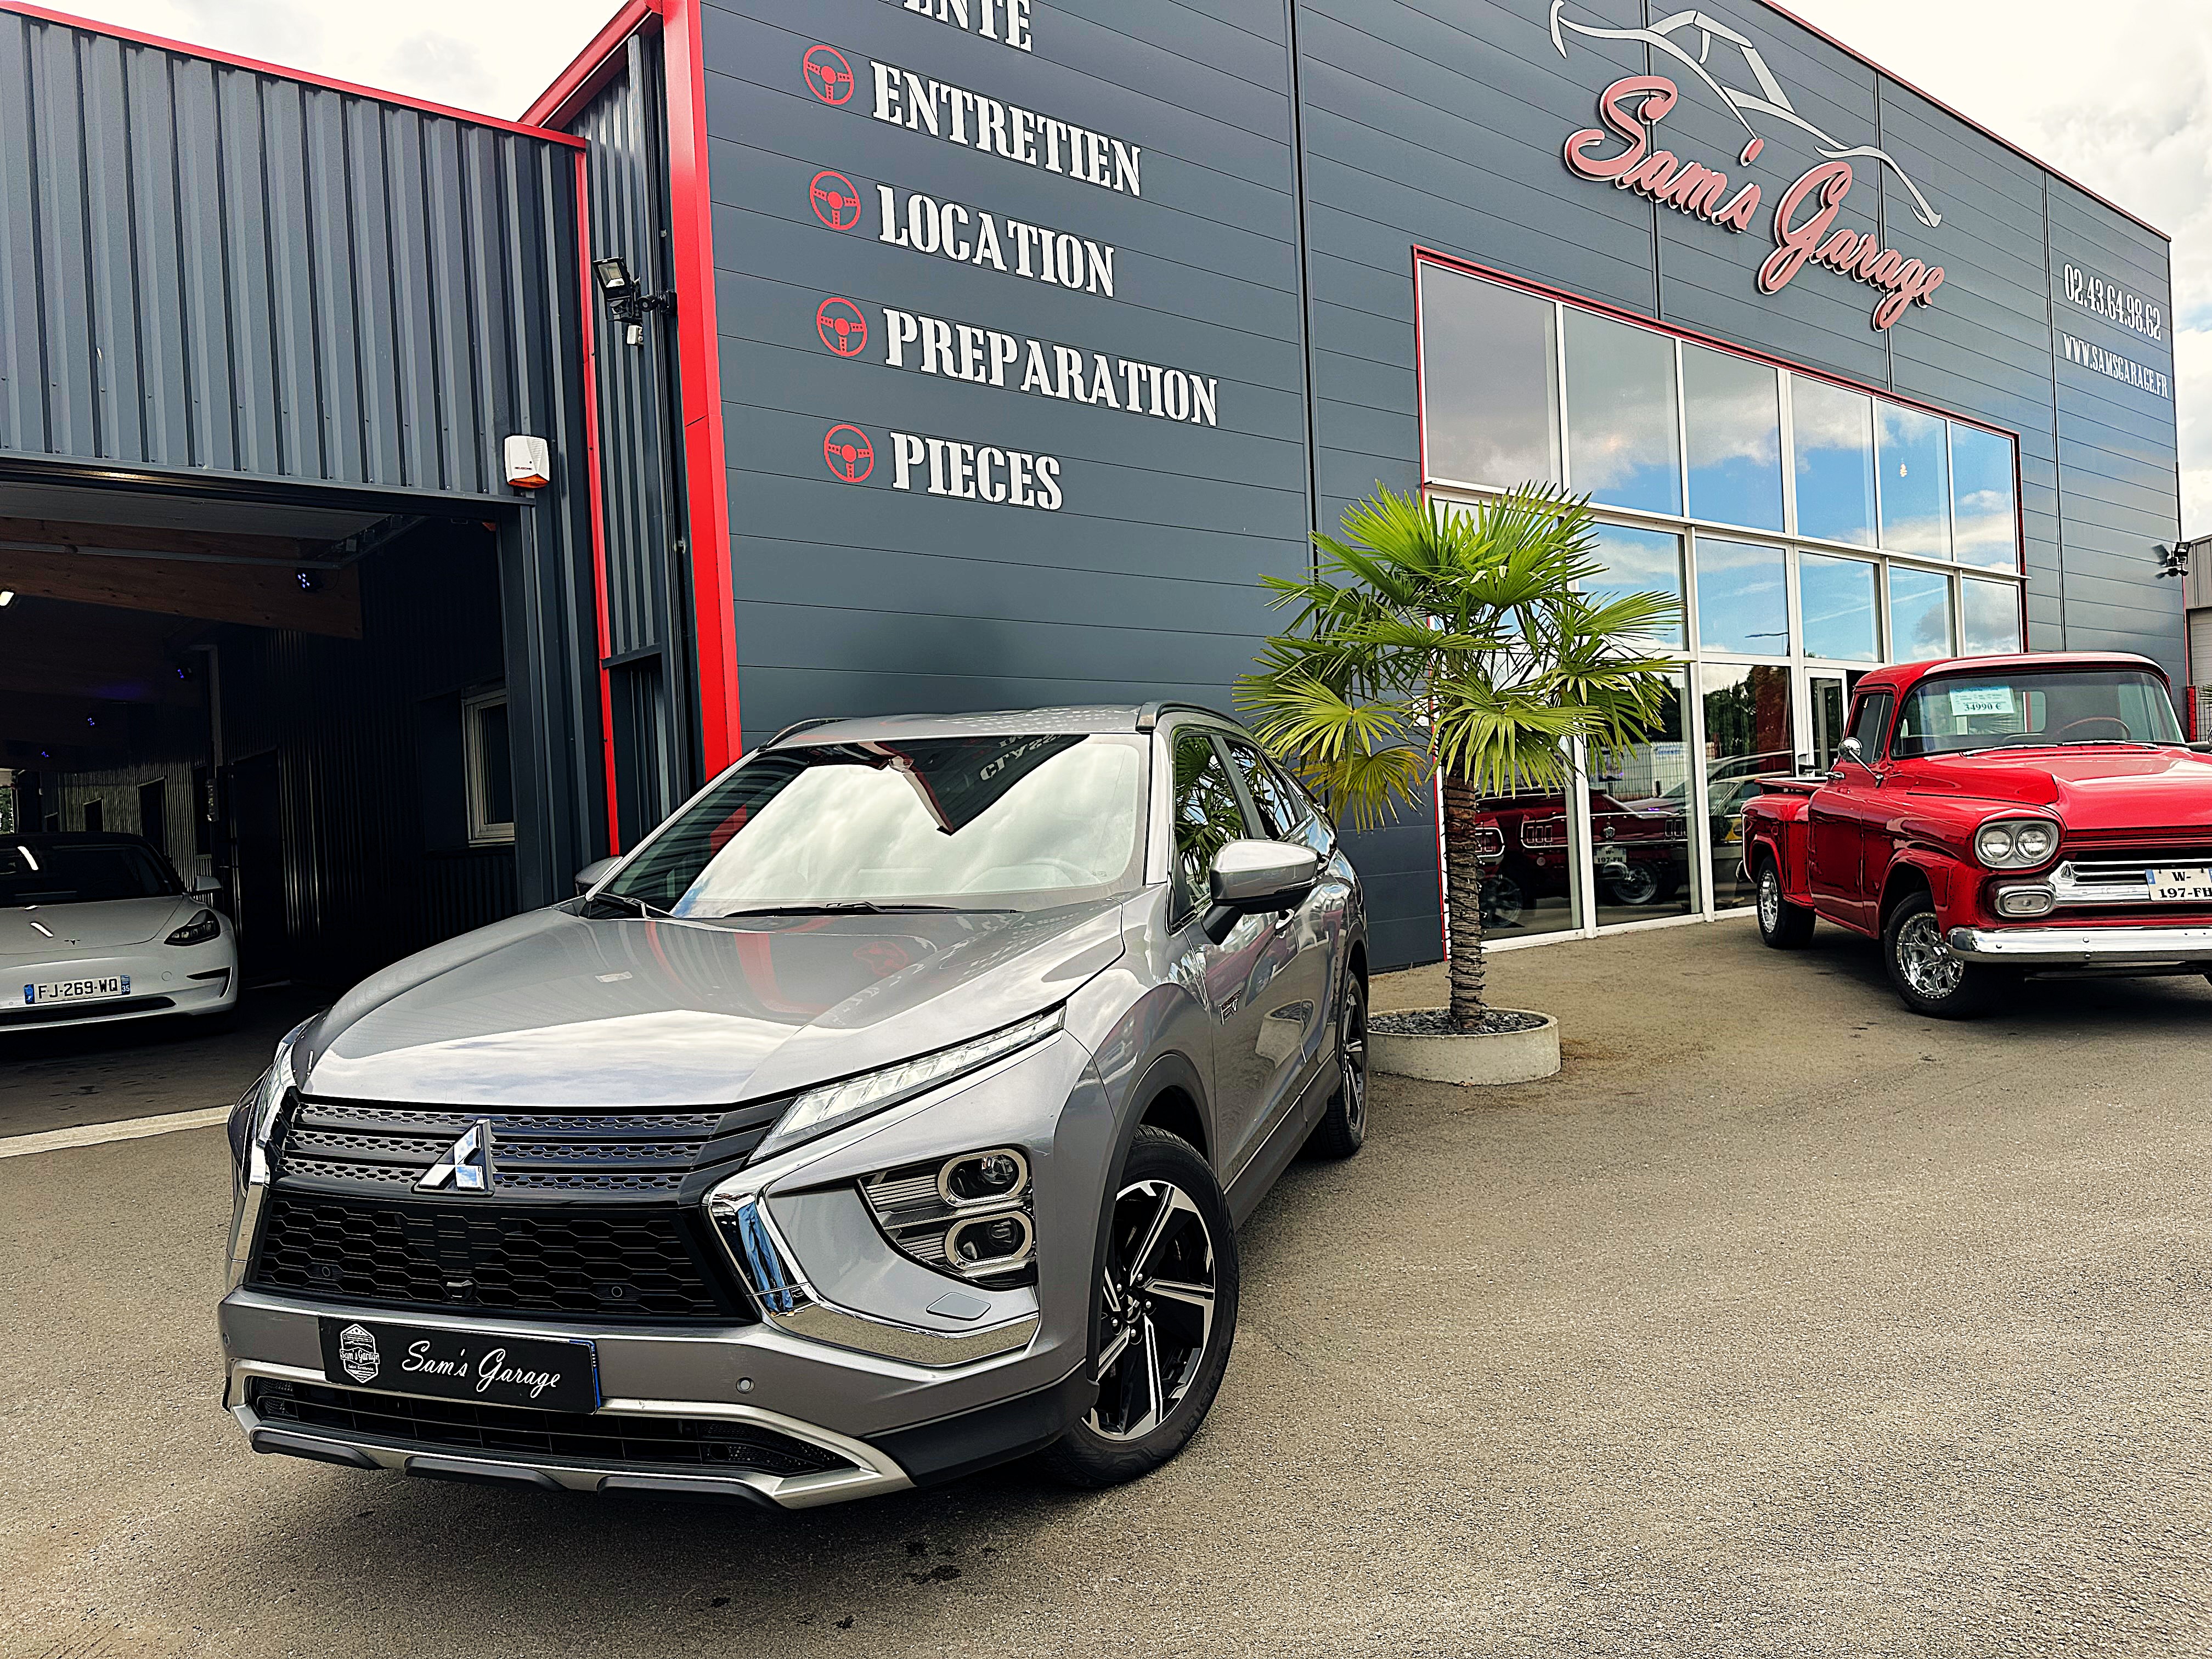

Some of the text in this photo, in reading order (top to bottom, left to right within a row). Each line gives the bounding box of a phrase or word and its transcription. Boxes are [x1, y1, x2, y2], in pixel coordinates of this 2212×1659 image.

[870, 60, 1142, 197] ENTRETIEN
[1565, 75, 1945, 332] Sam's Garage
[877, 183, 1115, 297] LOCATION
[2063, 263, 2161, 341] 02.43.64.98.62
[883, 307, 1218, 426] PREPARATION
[2062, 332, 2168, 398] WWW.SAMSGARAGE.FR
[890, 432, 1063, 510] PIECES
[1964, 702, 1993, 711] 34990
[2159, 887, 2212, 898] 197-FH
[2172, 872, 2191, 881] W-
[38, 979, 118, 998] FJ-269-WQ
[341, 1349, 379, 1363] Sam's Garage
[402, 1340, 561, 1398] Sam's Garage
